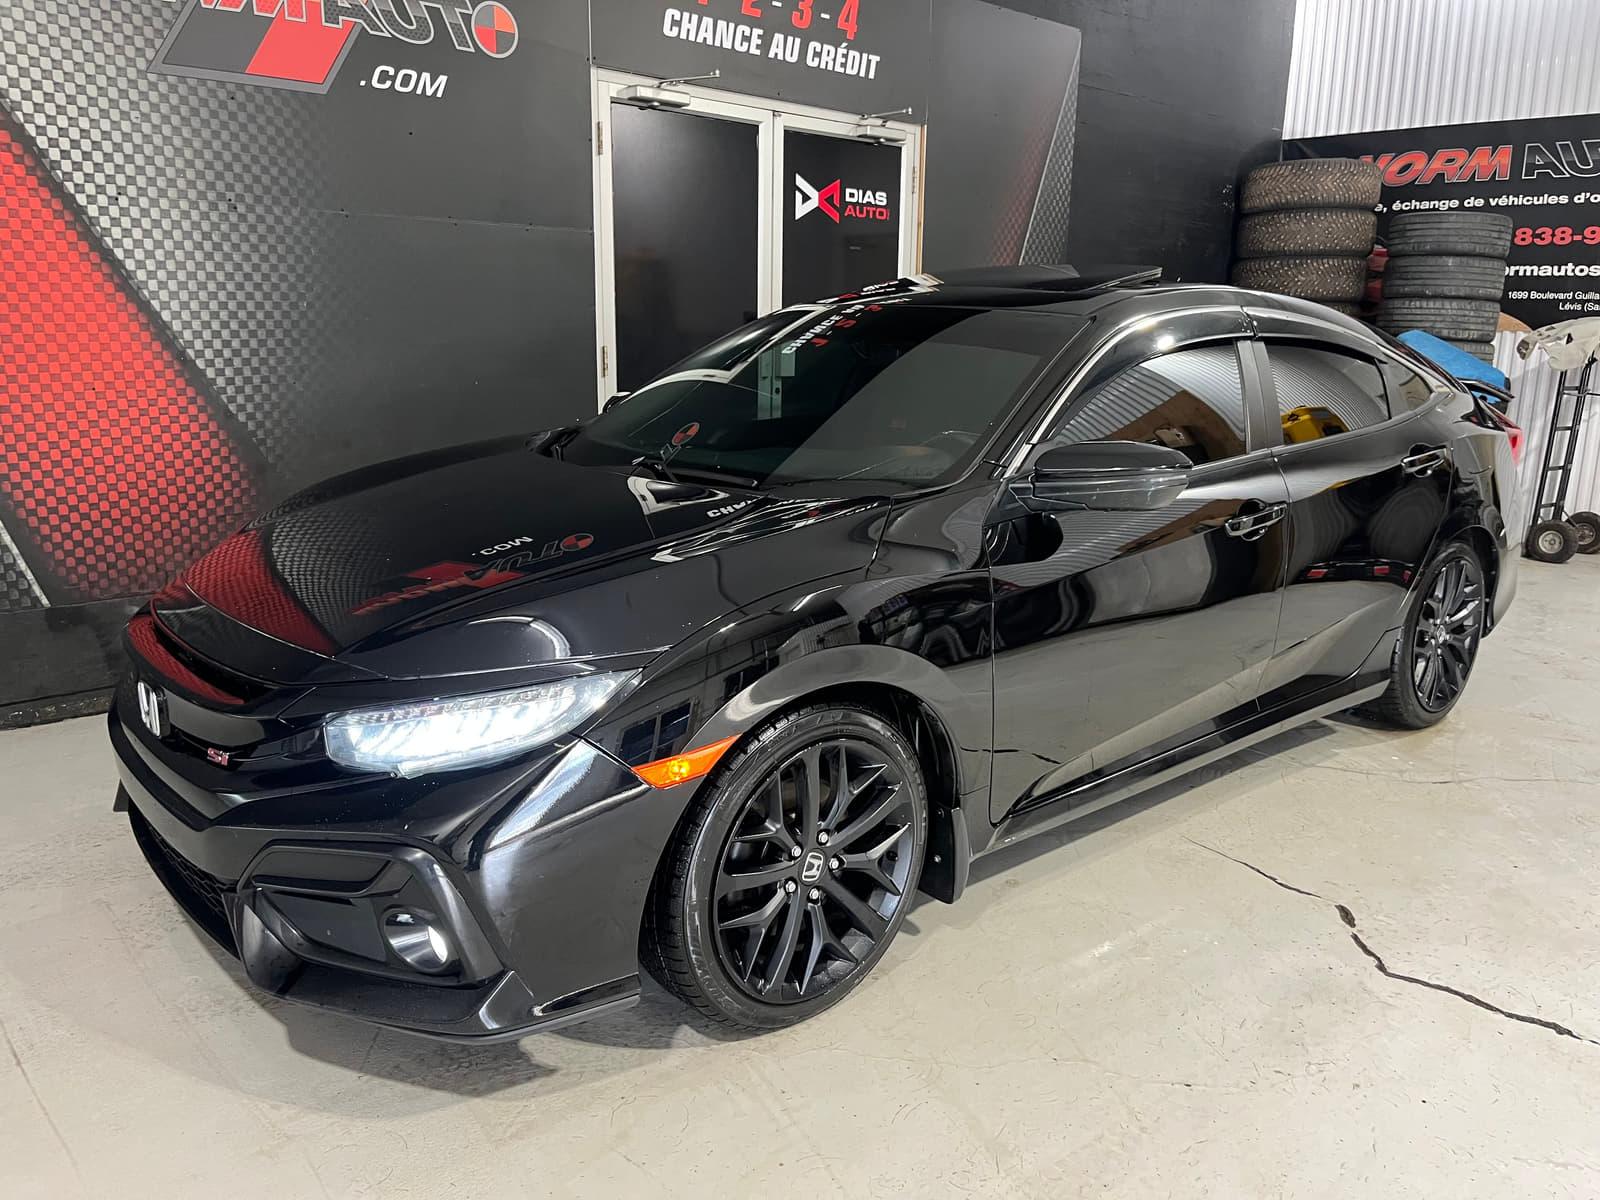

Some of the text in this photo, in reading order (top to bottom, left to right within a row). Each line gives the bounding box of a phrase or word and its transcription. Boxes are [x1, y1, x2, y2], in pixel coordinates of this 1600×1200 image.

[662, 7, 764, 56] CHANCE
[767, 32, 802, 63] AU
[806, 40, 881, 80] CRÉDIT
[359, 64, 448, 98] .COM
[1521, 139, 1600, 179] AU
[844, 187, 888, 206] DIAS
[1391, 199, 1460, 211] échange
[1463, 196, 1485, 207] de
[1488, 193, 1569, 206] véhicules
[844, 204, 887, 220] AUTO
[1513, 225, 1600, 246] 838-9
[1508, 290, 1529, 300] 1699
[1529, 290, 1574, 300] Boulevard
[1559, 301, 1583, 311] Lévis
